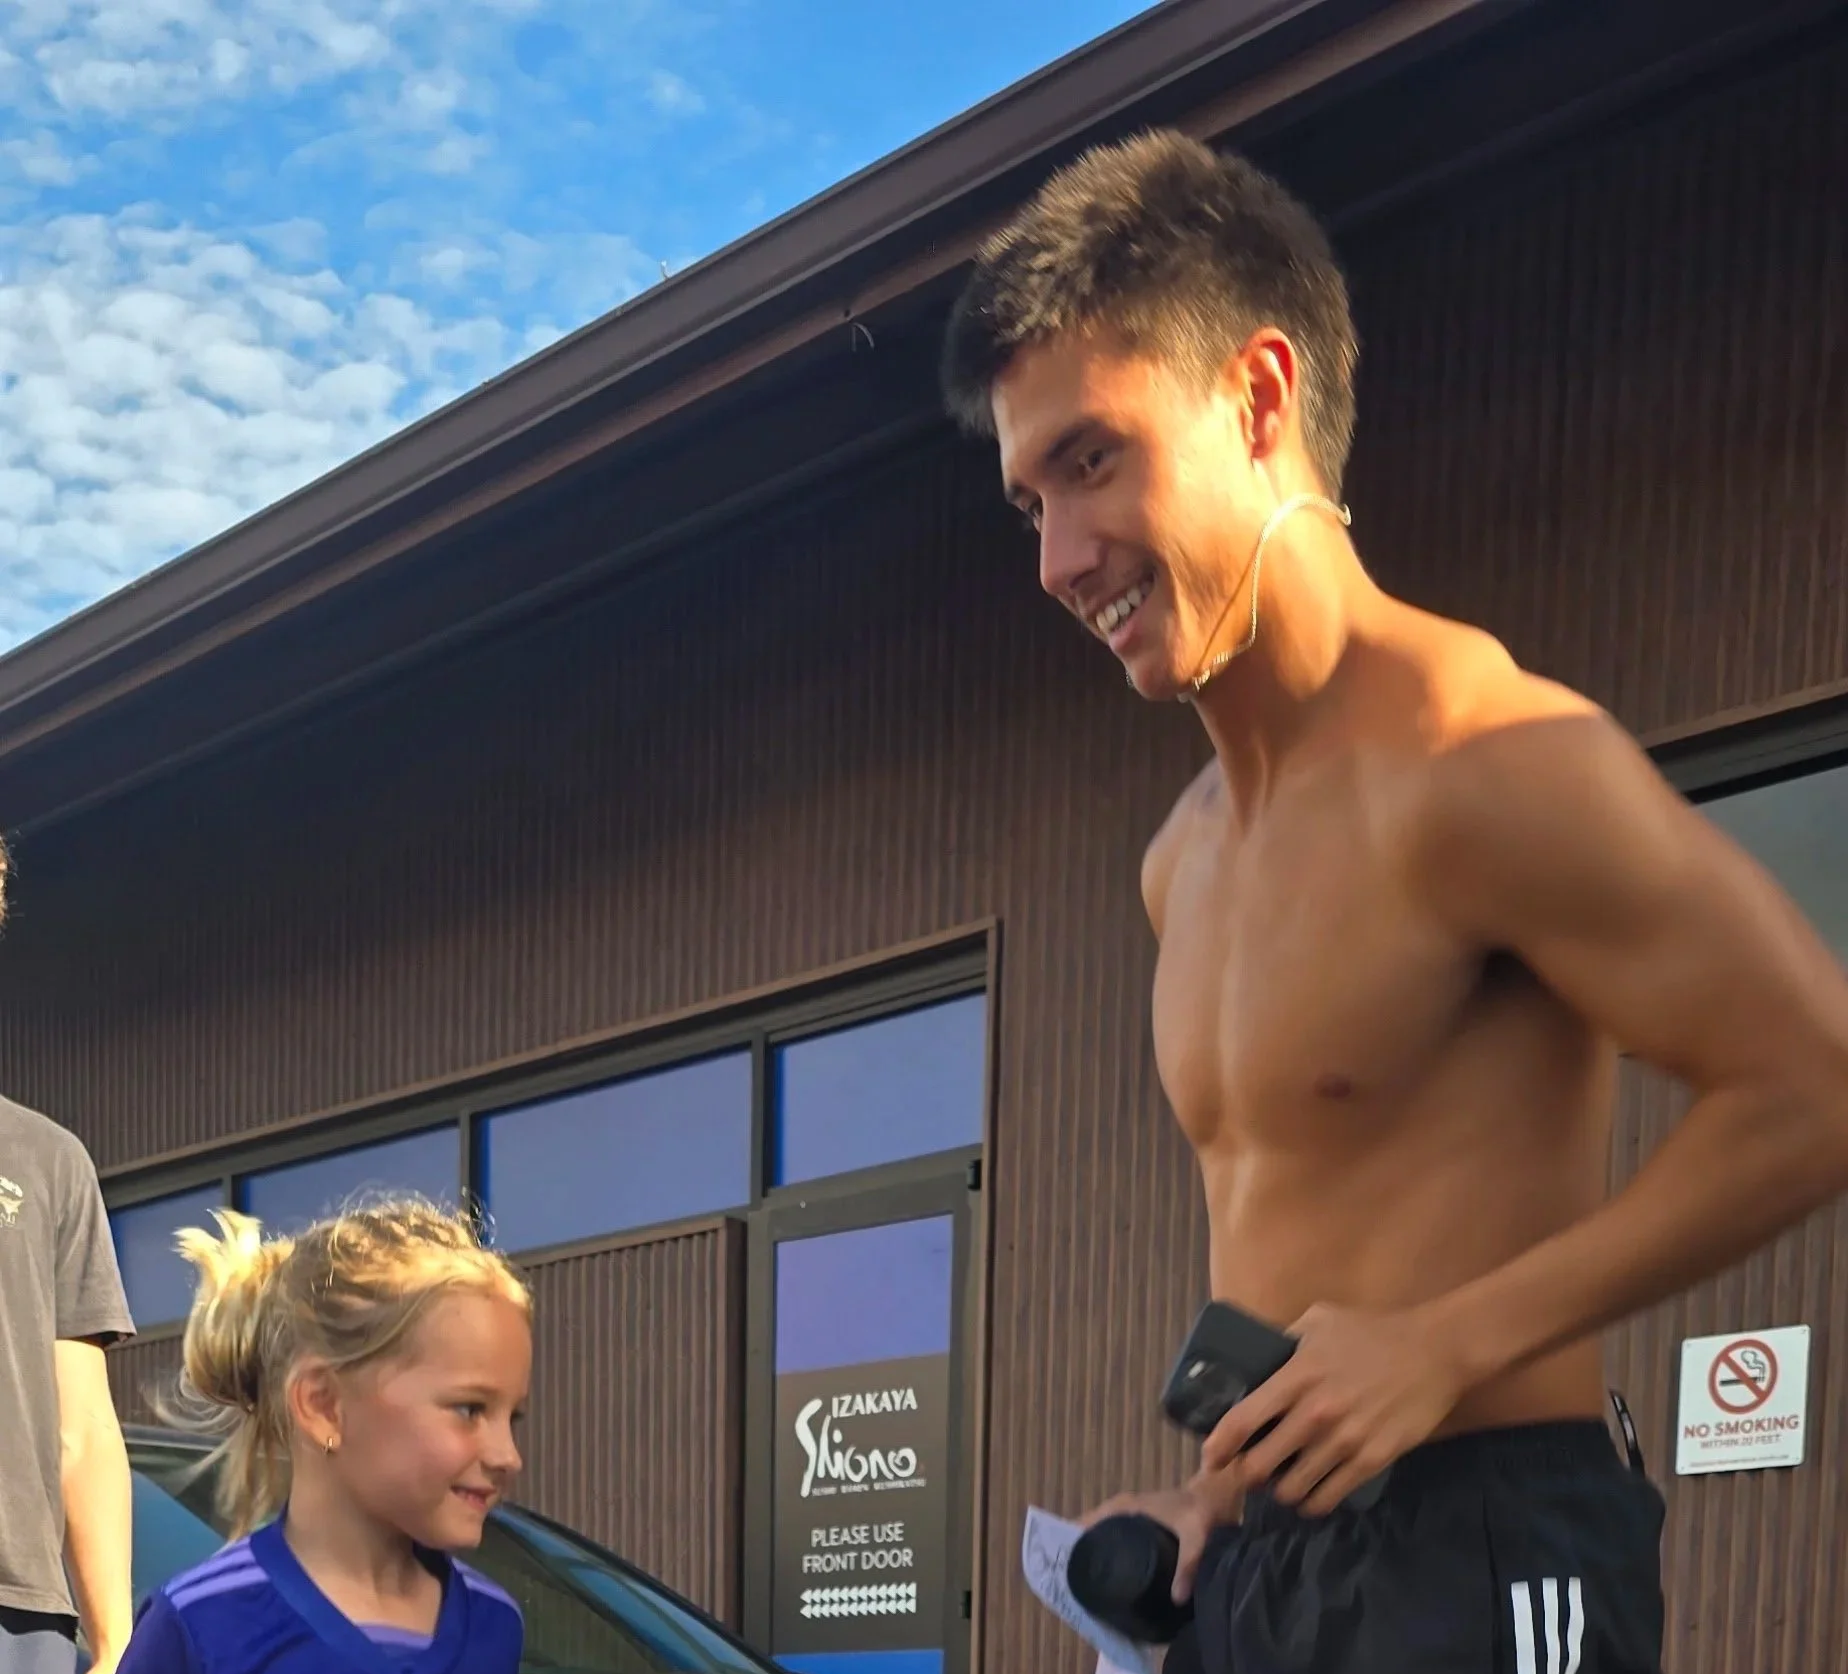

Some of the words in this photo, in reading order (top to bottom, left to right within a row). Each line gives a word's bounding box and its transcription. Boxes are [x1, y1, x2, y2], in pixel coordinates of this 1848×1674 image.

[832, 1388, 918, 1418] IZAKAYA
[1684, 1422, 1710, 1439] NO
[1714, 1414, 1799, 1436] SMOKING
[1700, 1438, 1739, 1449] WITHIN
[1755, 1433, 1781, 1445] FEET
[811, 1525, 869, 1548] PLEASE
[873, 1522, 904, 1543] USE
[803, 1552, 858, 1574] FRONT
[861, 1548, 913, 1571] DOOR
